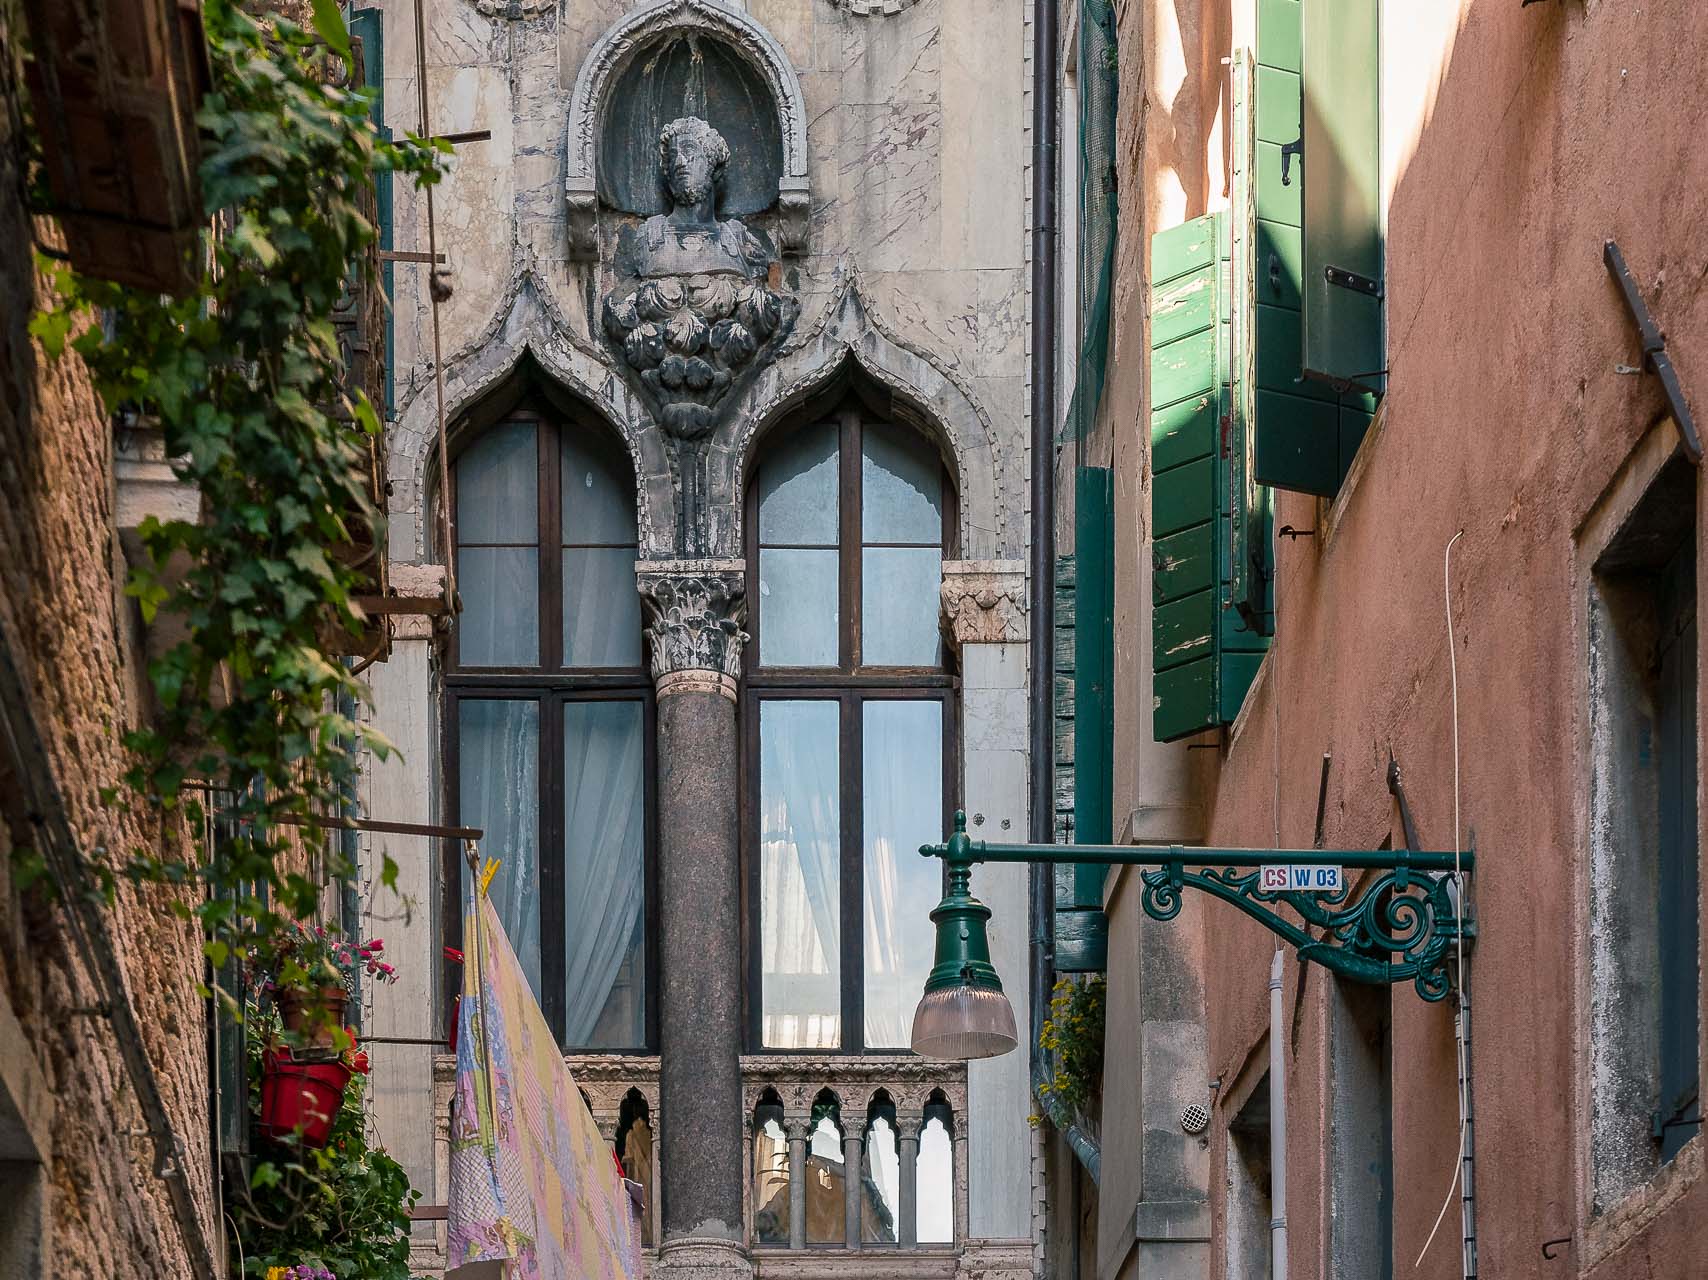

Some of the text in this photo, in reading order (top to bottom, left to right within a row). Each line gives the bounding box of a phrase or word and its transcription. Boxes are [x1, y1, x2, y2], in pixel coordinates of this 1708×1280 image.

[1265, 868, 1337, 887] CS W 03
